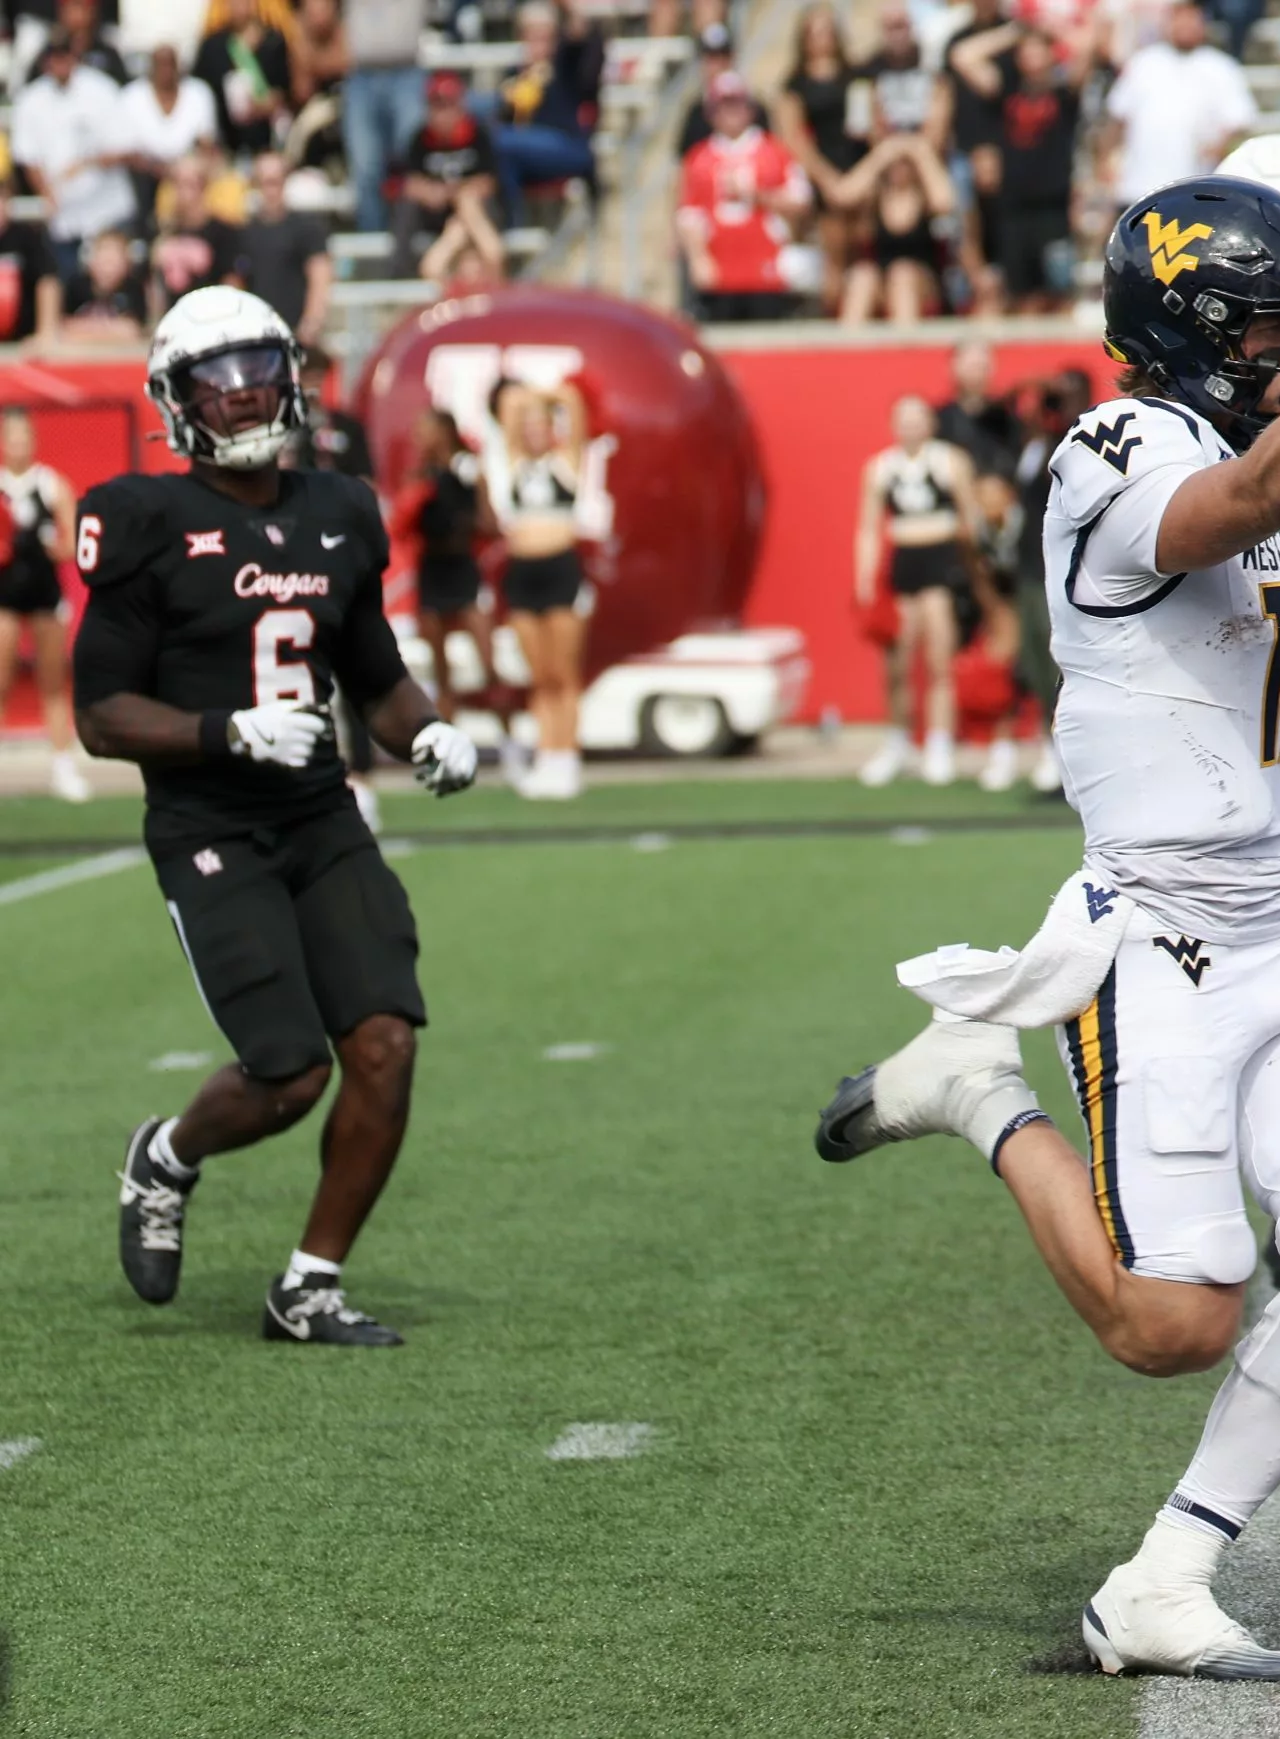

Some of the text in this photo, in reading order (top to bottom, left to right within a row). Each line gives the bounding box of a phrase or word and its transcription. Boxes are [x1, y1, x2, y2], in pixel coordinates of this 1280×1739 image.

[76, 514, 103, 571] 6
[234, 562, 330, 604] Cougars
[252, 607, 317, 710] 6
